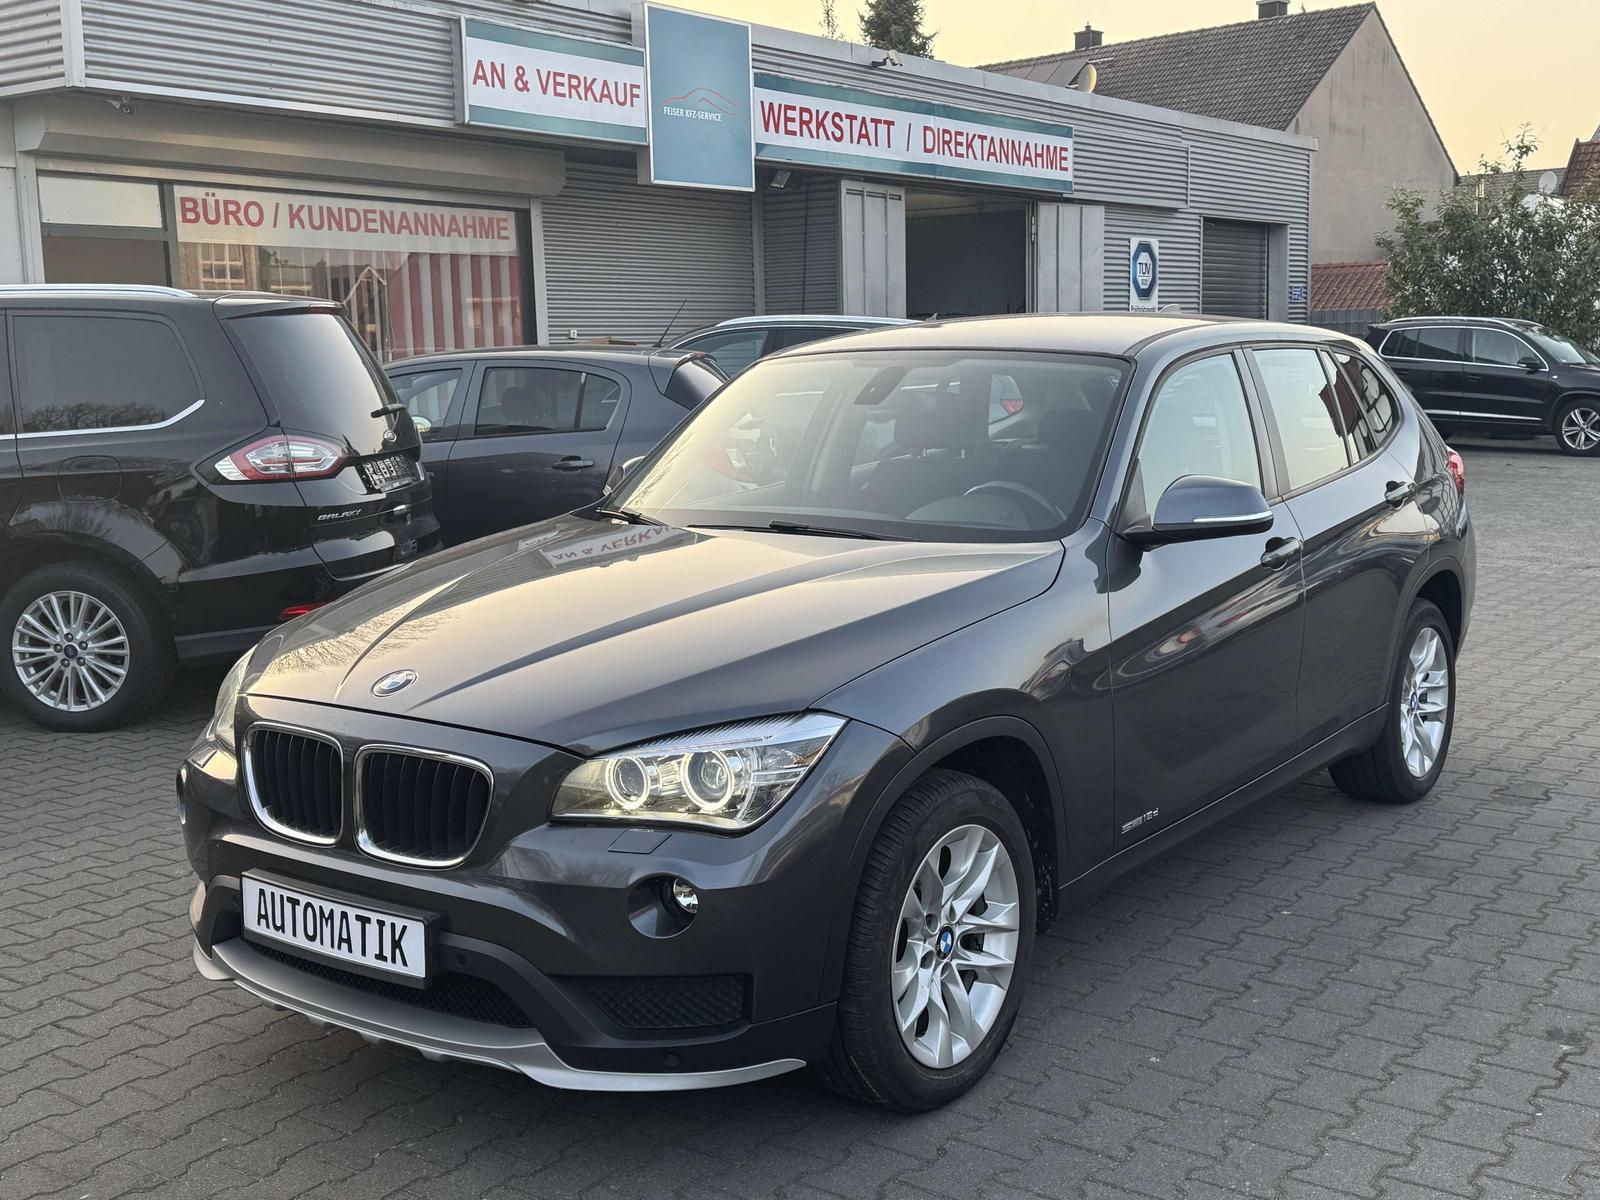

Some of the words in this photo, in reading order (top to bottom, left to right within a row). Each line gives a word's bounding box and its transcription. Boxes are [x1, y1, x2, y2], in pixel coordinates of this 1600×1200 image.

[472, 59, 506, 90] AN
[513, 65, 530, 93] &
[536, 68, 641, 108] VERKAUF
[663, 106, 685, 117] FEISER
[685, 109, 722, 122] KFZ-SERVICE
[760, 100, 895, 149] WERKSTATT
[906, 123, 912, 152] /
[922, 125, 1069, 172] DIREKTANNAHME
[180, 191, 264, 228] BÜRO
[272, 203, 280, 229] /
[288, 204, 510, 241] KUNDENANNAHME
[318, 508, 361, 521] GALAXY
[256, 887, 409, 968] AUTOMATIK
